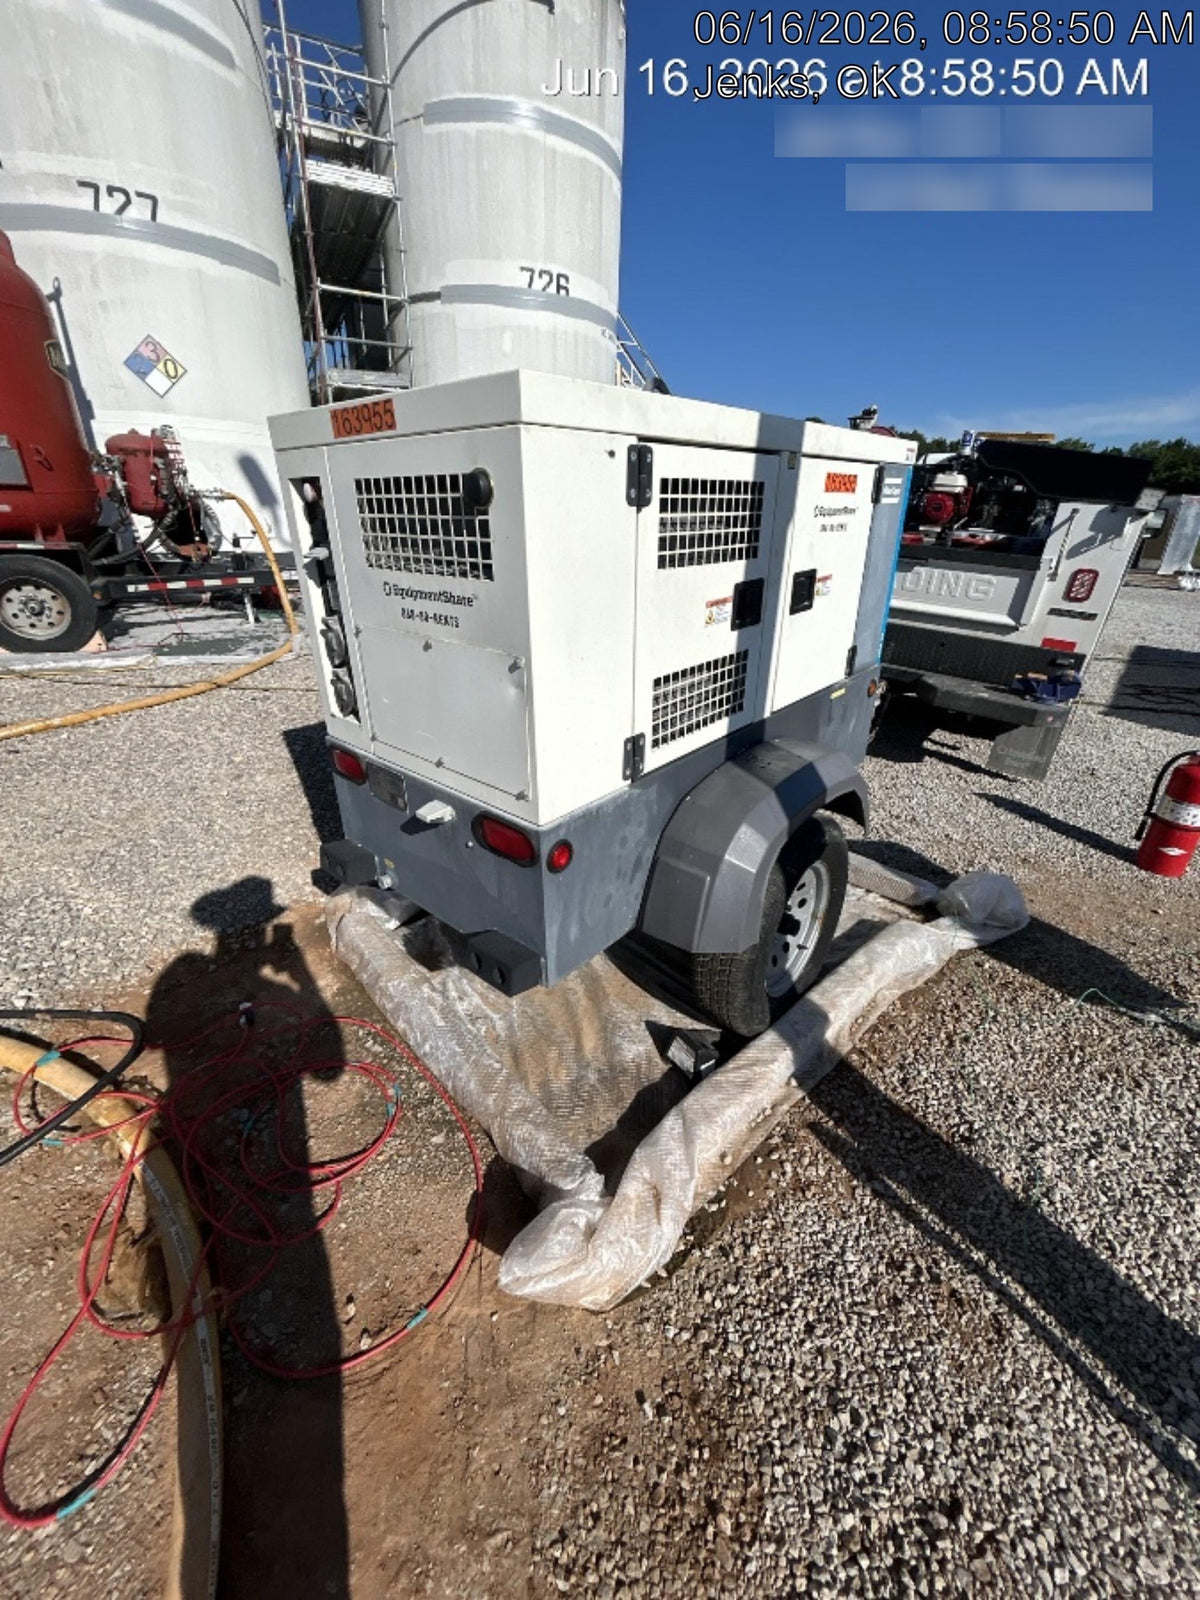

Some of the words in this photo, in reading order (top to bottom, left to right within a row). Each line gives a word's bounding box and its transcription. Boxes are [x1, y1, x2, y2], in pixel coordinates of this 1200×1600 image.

[76, 179, 158, 223] 727
[519, 266, 570, 297] 726
[145, 340, 160, 363] 3
[163, 358, 178, 379] 0
[331, 398, 396, 436] 163955
